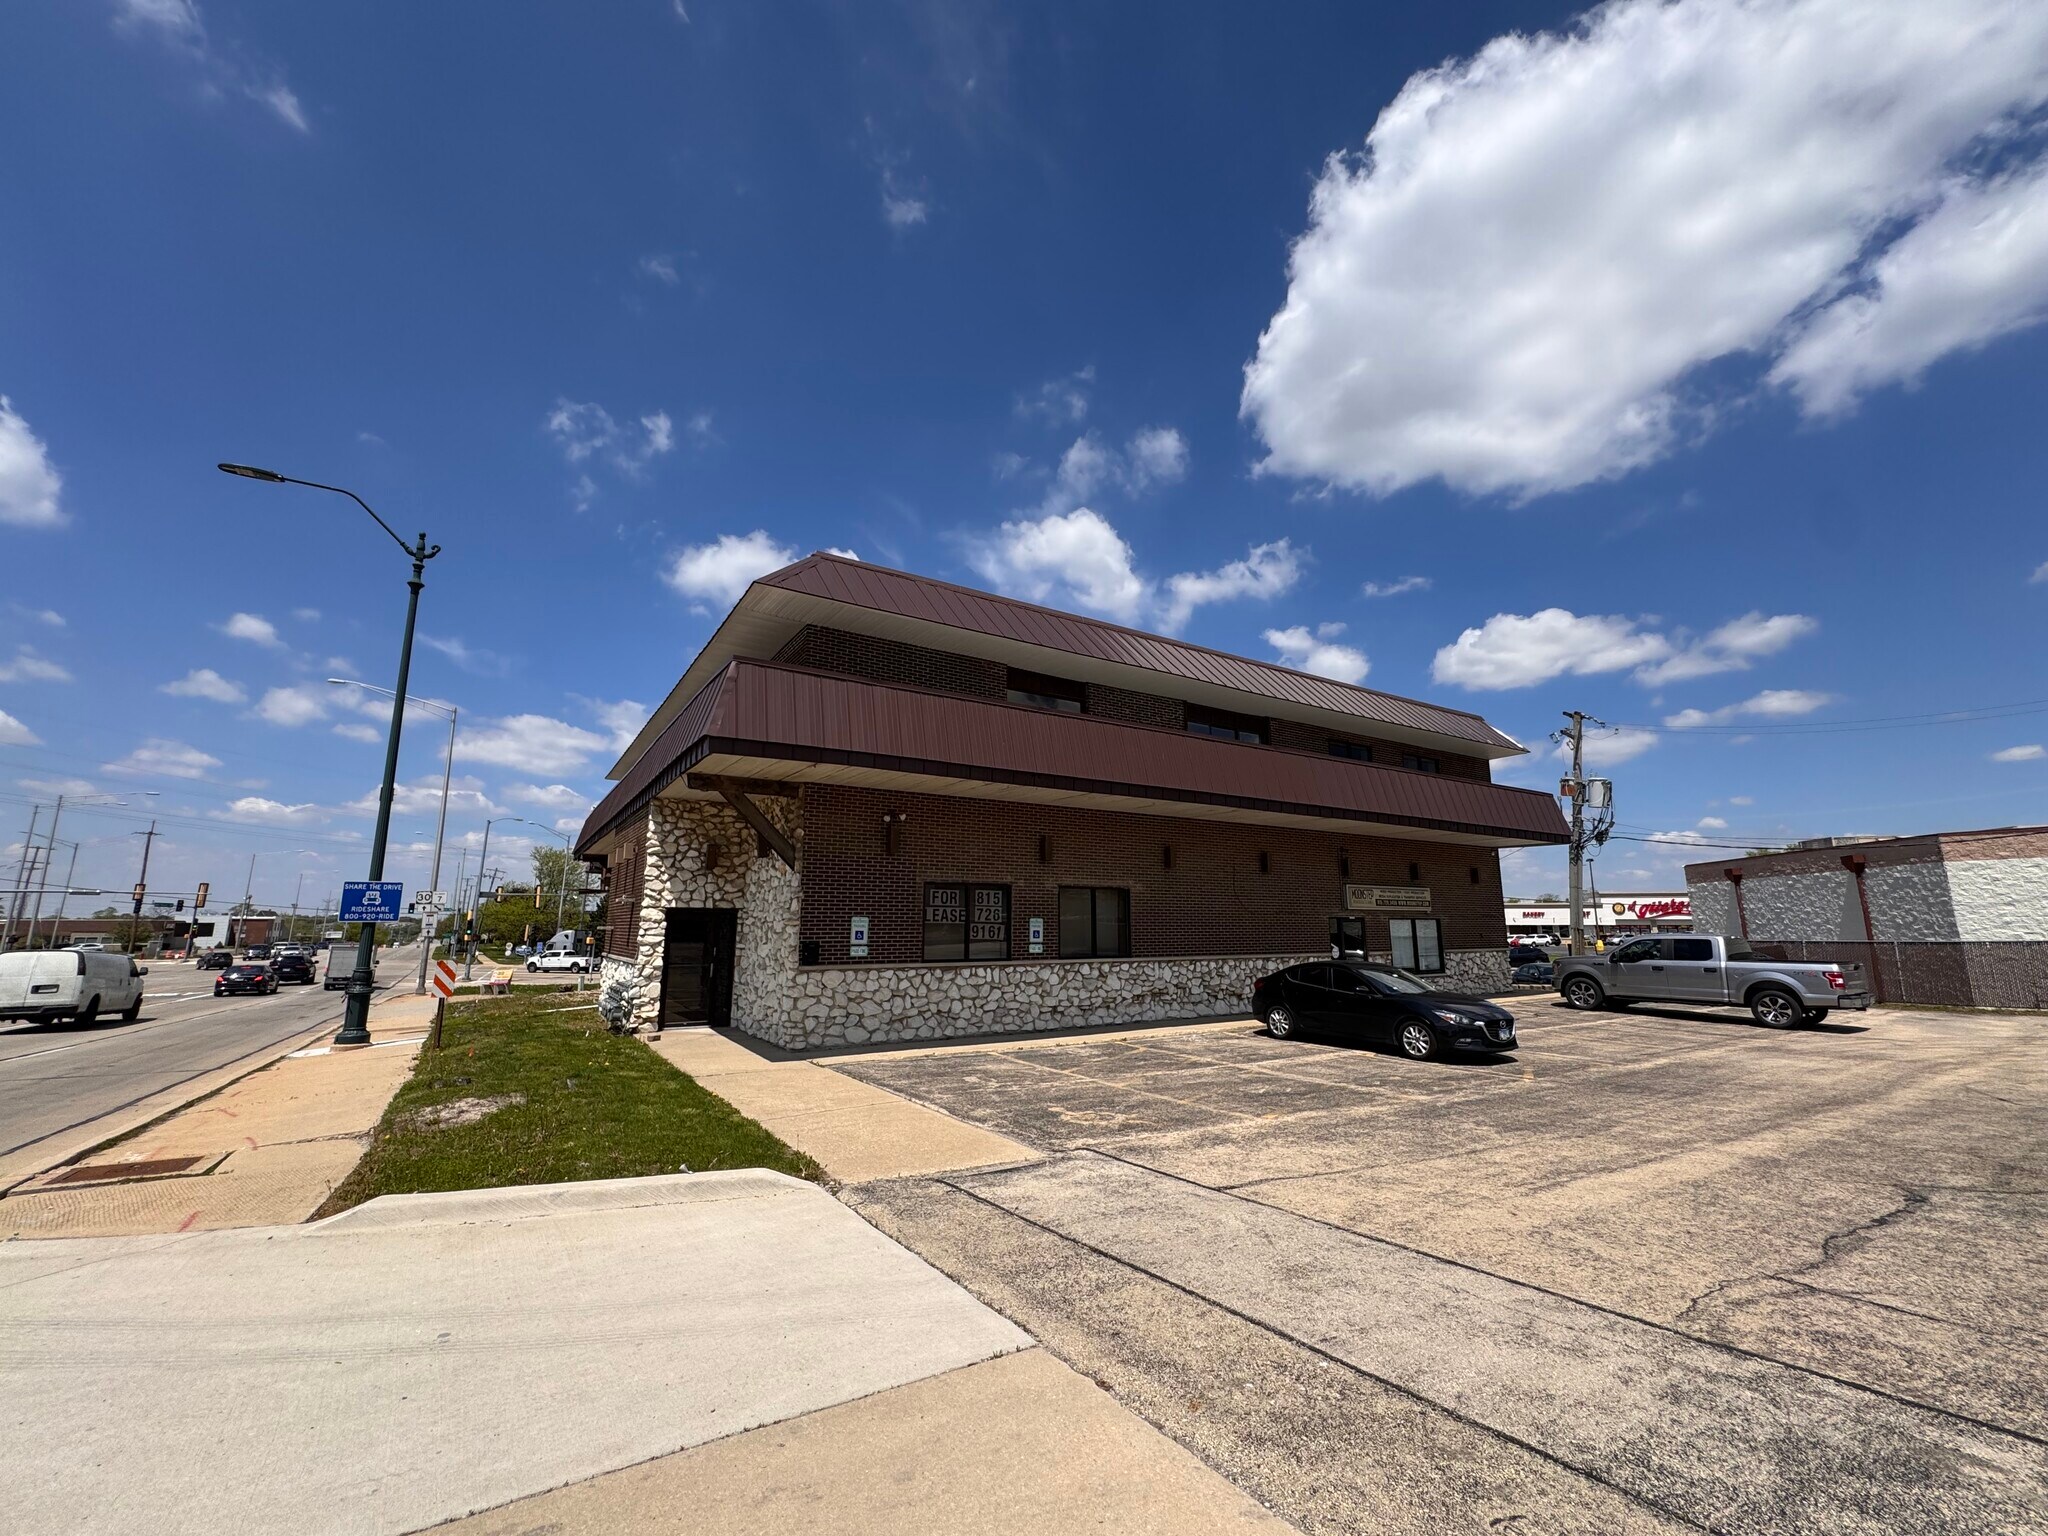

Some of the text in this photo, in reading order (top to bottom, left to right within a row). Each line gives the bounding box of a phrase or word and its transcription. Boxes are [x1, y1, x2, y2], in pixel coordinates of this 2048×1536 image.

[417, 893, 431, 902] 30
[932, 891, 958, 904] FOR
[977, 891, 1000, 905] 815
[925, 908, 966, 922] LEASE
[976, 908, 1000, 921] 726
[1522, 911, 1546, 919] BAKERY
[971, 925, 1002, 939] 9161
